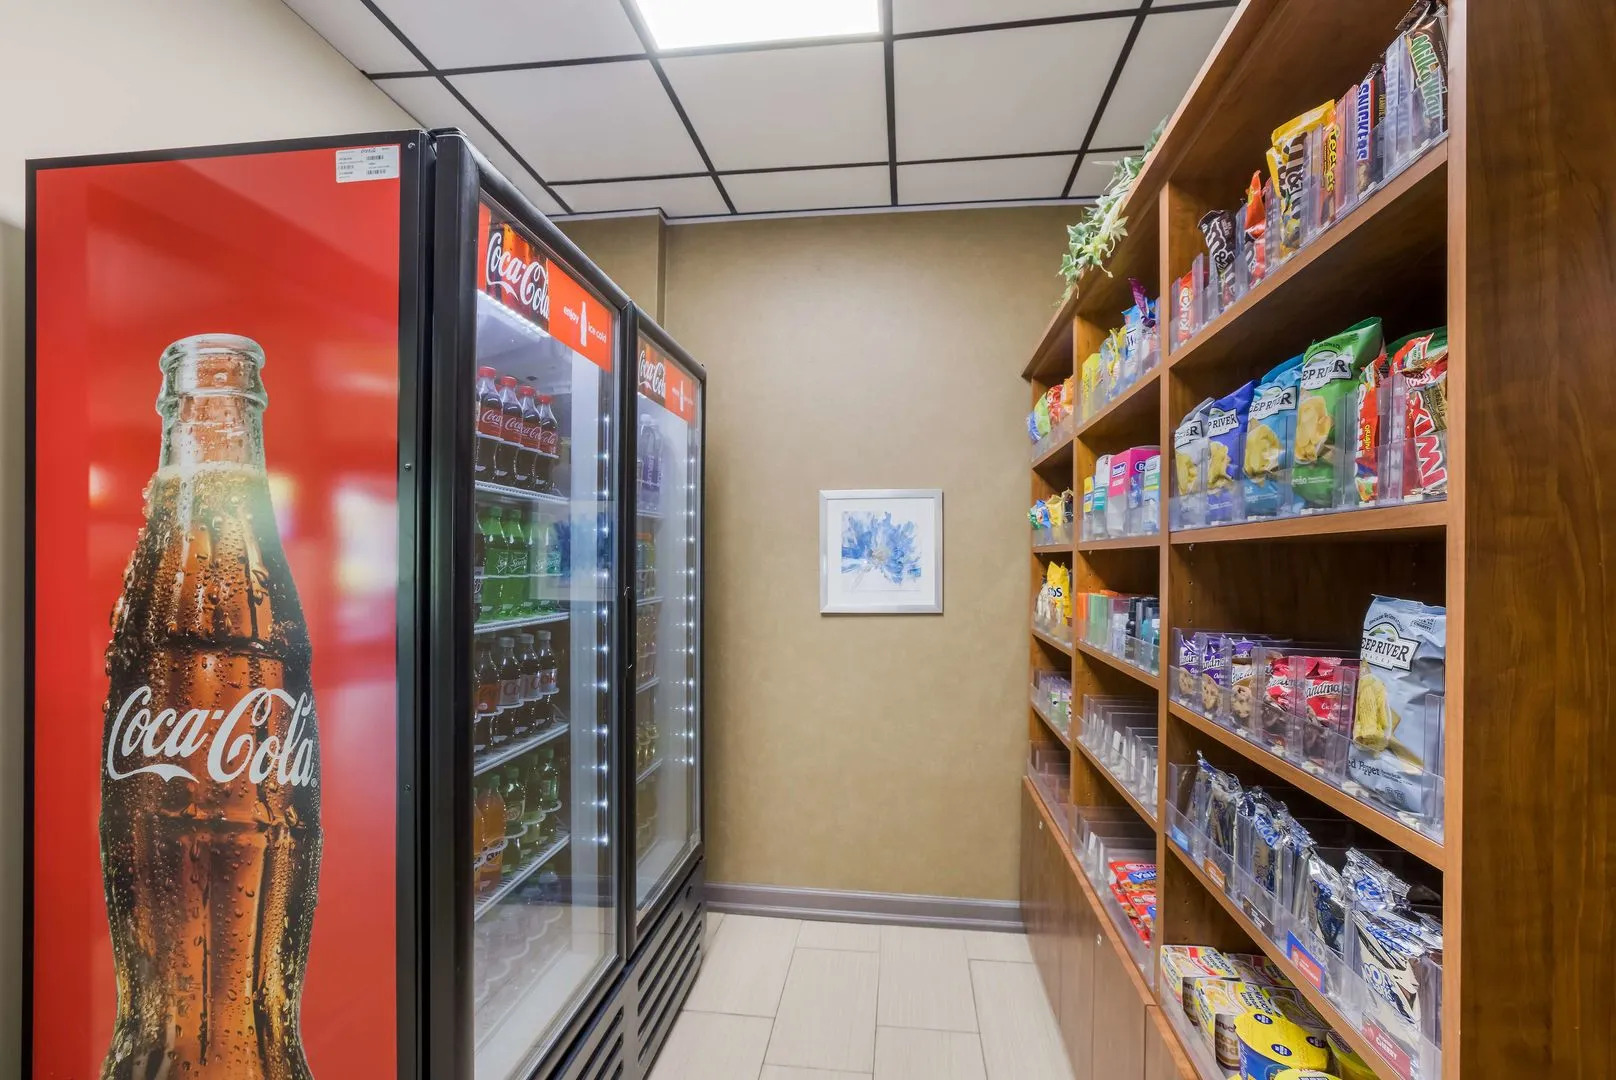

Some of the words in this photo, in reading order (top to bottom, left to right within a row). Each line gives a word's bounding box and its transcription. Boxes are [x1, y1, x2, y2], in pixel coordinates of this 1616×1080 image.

[1357, 83, 1369, 160] SNICKERS
[486, 232, 550, 319] Coca-Cola
[563, 306, 580, 324] enjoy
[588, 322, 597, 335] ice
[596, 331, 607, 343] cold
[1213, 414, 1237, 429] RIVER
[1374, 642, 1409, 662] RIVER
[107, 686, 313, 787] Coca-Cola
[1359, 761, 1380, 776] Pepper
